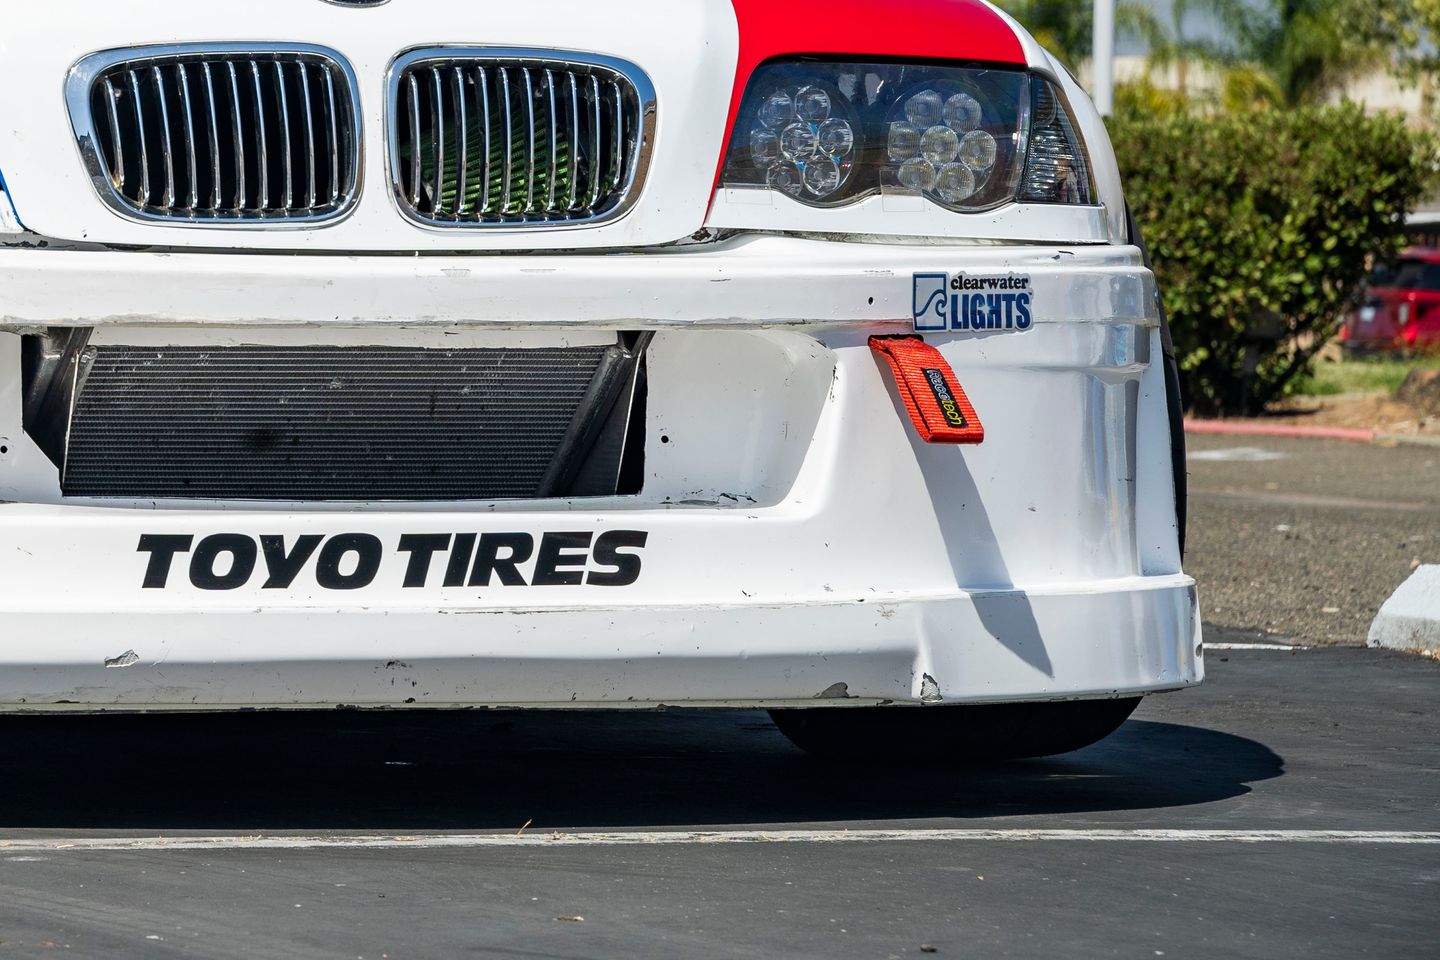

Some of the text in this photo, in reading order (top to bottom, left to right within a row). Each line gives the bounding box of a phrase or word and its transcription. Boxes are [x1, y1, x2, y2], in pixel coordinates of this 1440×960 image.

[950, 275, 1029, 290] clearwater
[951, 292, 1031, 330] LIGHTS
[926, 369, 962, 425] Racetech
[136, 529, 649, 590] TOYO TIRES
